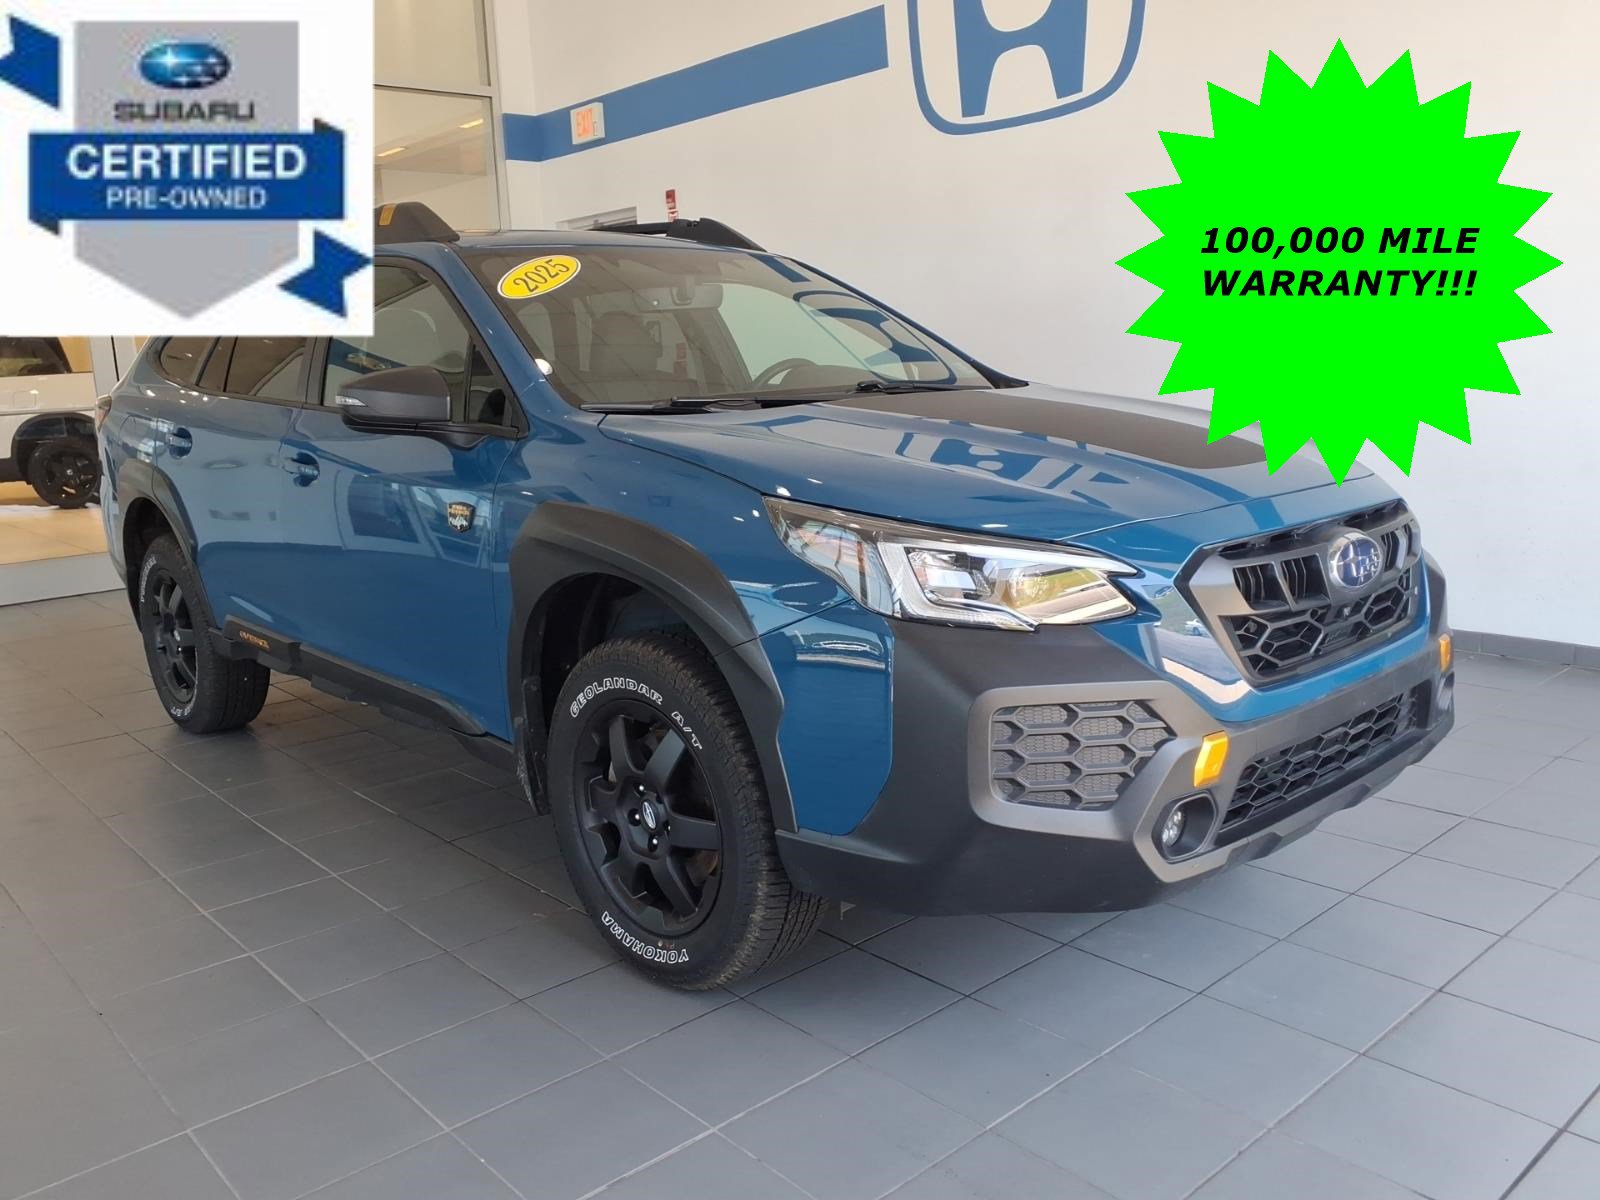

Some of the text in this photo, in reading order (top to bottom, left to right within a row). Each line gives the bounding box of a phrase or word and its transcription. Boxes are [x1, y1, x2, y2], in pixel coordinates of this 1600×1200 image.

[513, 258, 570, 293] 2025
[570, 677, 703, 750] GEOLANDAR A/T
[601, 911, 690, 964] YOKOHAMA
